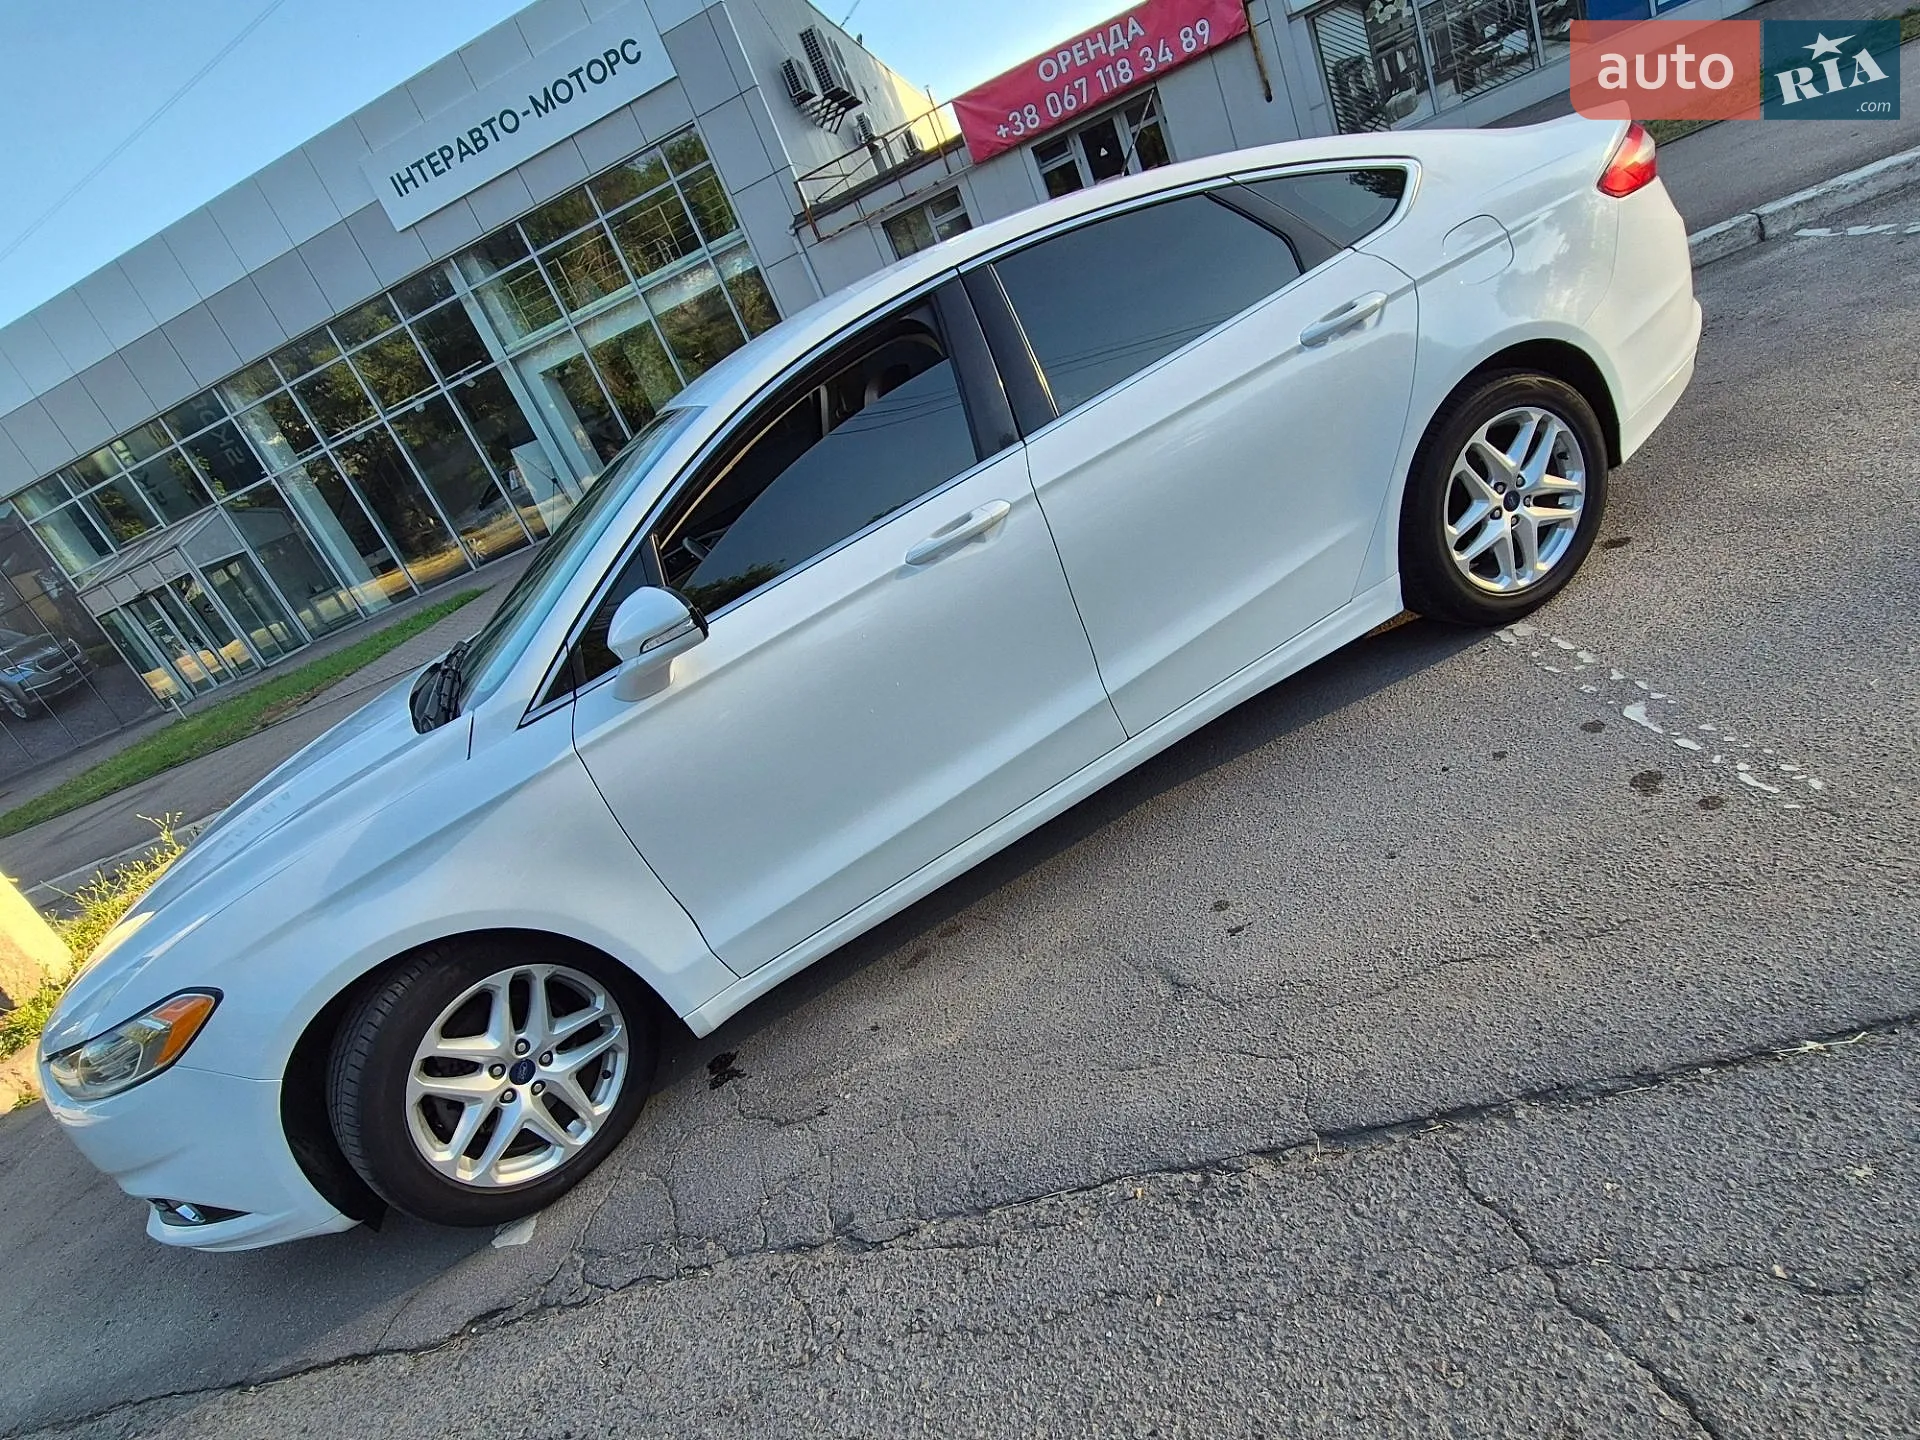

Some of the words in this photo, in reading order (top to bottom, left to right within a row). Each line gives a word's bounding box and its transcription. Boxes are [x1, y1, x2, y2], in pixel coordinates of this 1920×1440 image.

[997, 103, 1041, 139] +38
[1046, 78, 1089, 118] 067
[1096, 57, 1134, 94] 118
[1139, 39, 1173, 73] 34
[1179, 18, 1211, 53] 89
[1038, 16, 1145, 82] ОРЕНДА
[390, 38, 642, 197] ІНТЕРАВТО-МОТОРС
